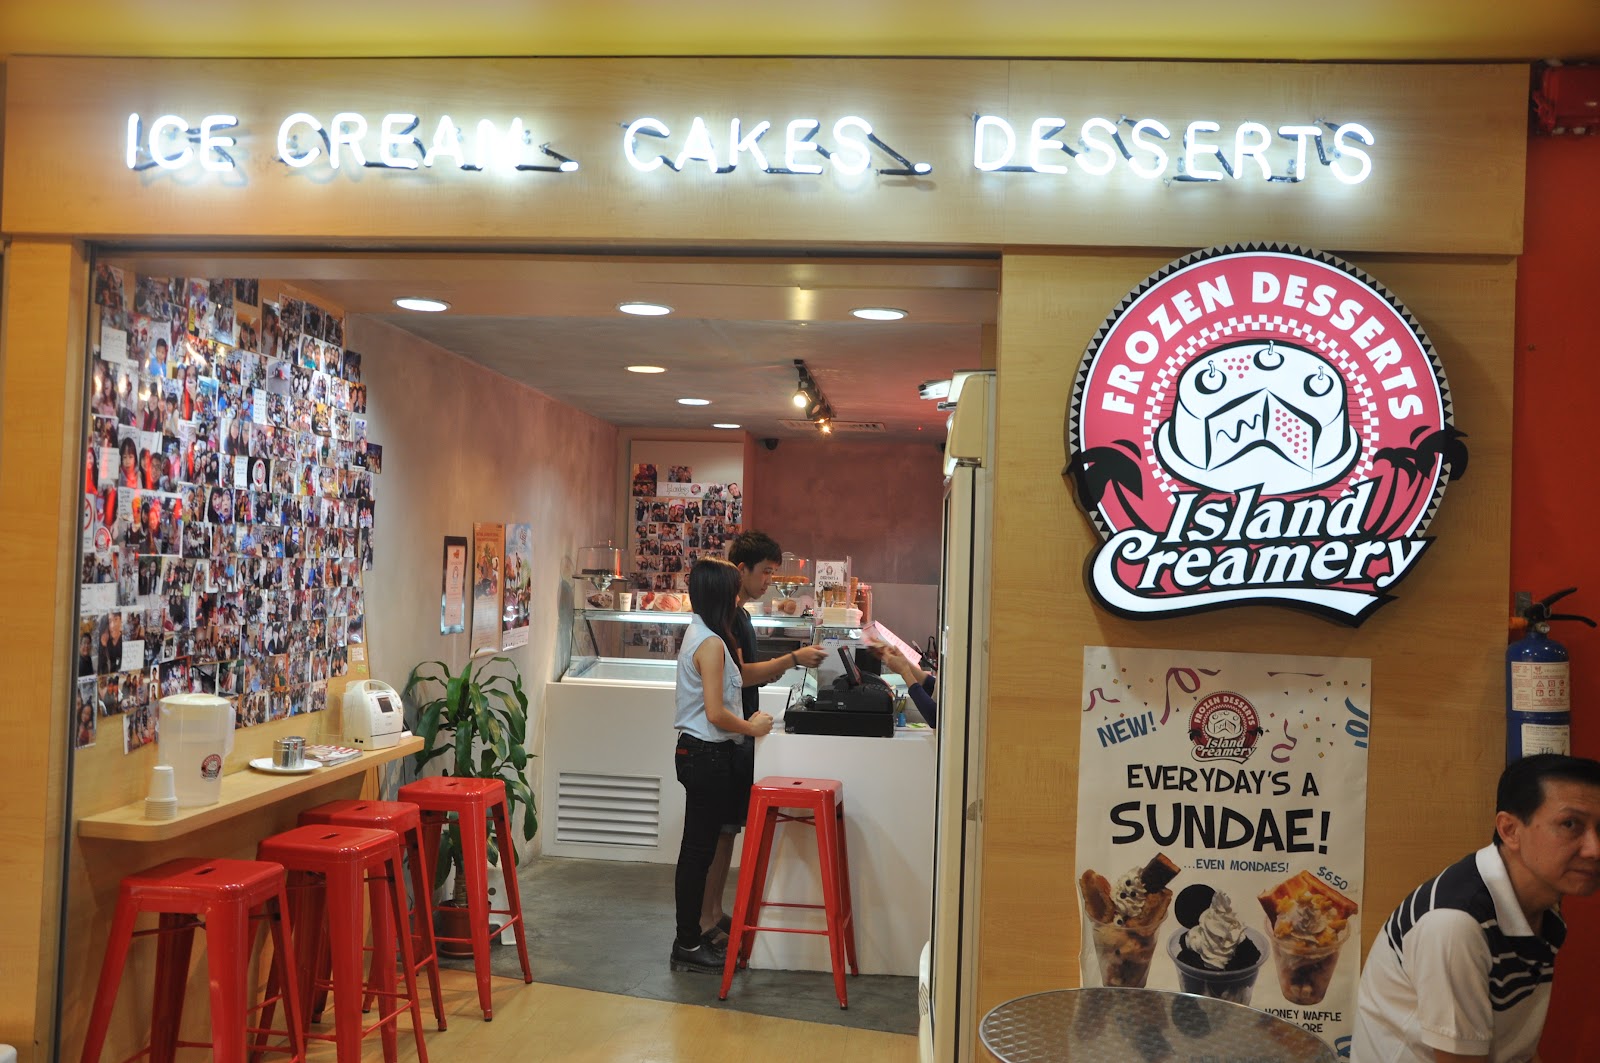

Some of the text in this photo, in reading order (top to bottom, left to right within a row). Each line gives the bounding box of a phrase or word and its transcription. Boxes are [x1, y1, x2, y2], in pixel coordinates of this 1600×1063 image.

[126, 112, 1376, 185] ICE CREAM CAKES DESSERTS
[1101, 271, 1424, 420] FROZEN DESSERTS
[1162, 482, 1377, 544] Island
[1092, 529, 1429, 616] Creamery
[1193, 695, 1256, 726] FROZEN DESSERTS
[1096, 711, 1157, 748] NEW!
[1205, 737, 1246, 748] Island
[1191, 744, 1258, 764] Creamery
[1127, 764, 1320, 797] EVERYDAY'S A
[1109, 801, 1331, 855] SUNDAE!
[1229, 860, 1290, 873] MONDAES!
[1316, 866, 1349, 891] $6.50
[1303, 1010, 1342, 1022] WAFFLE
